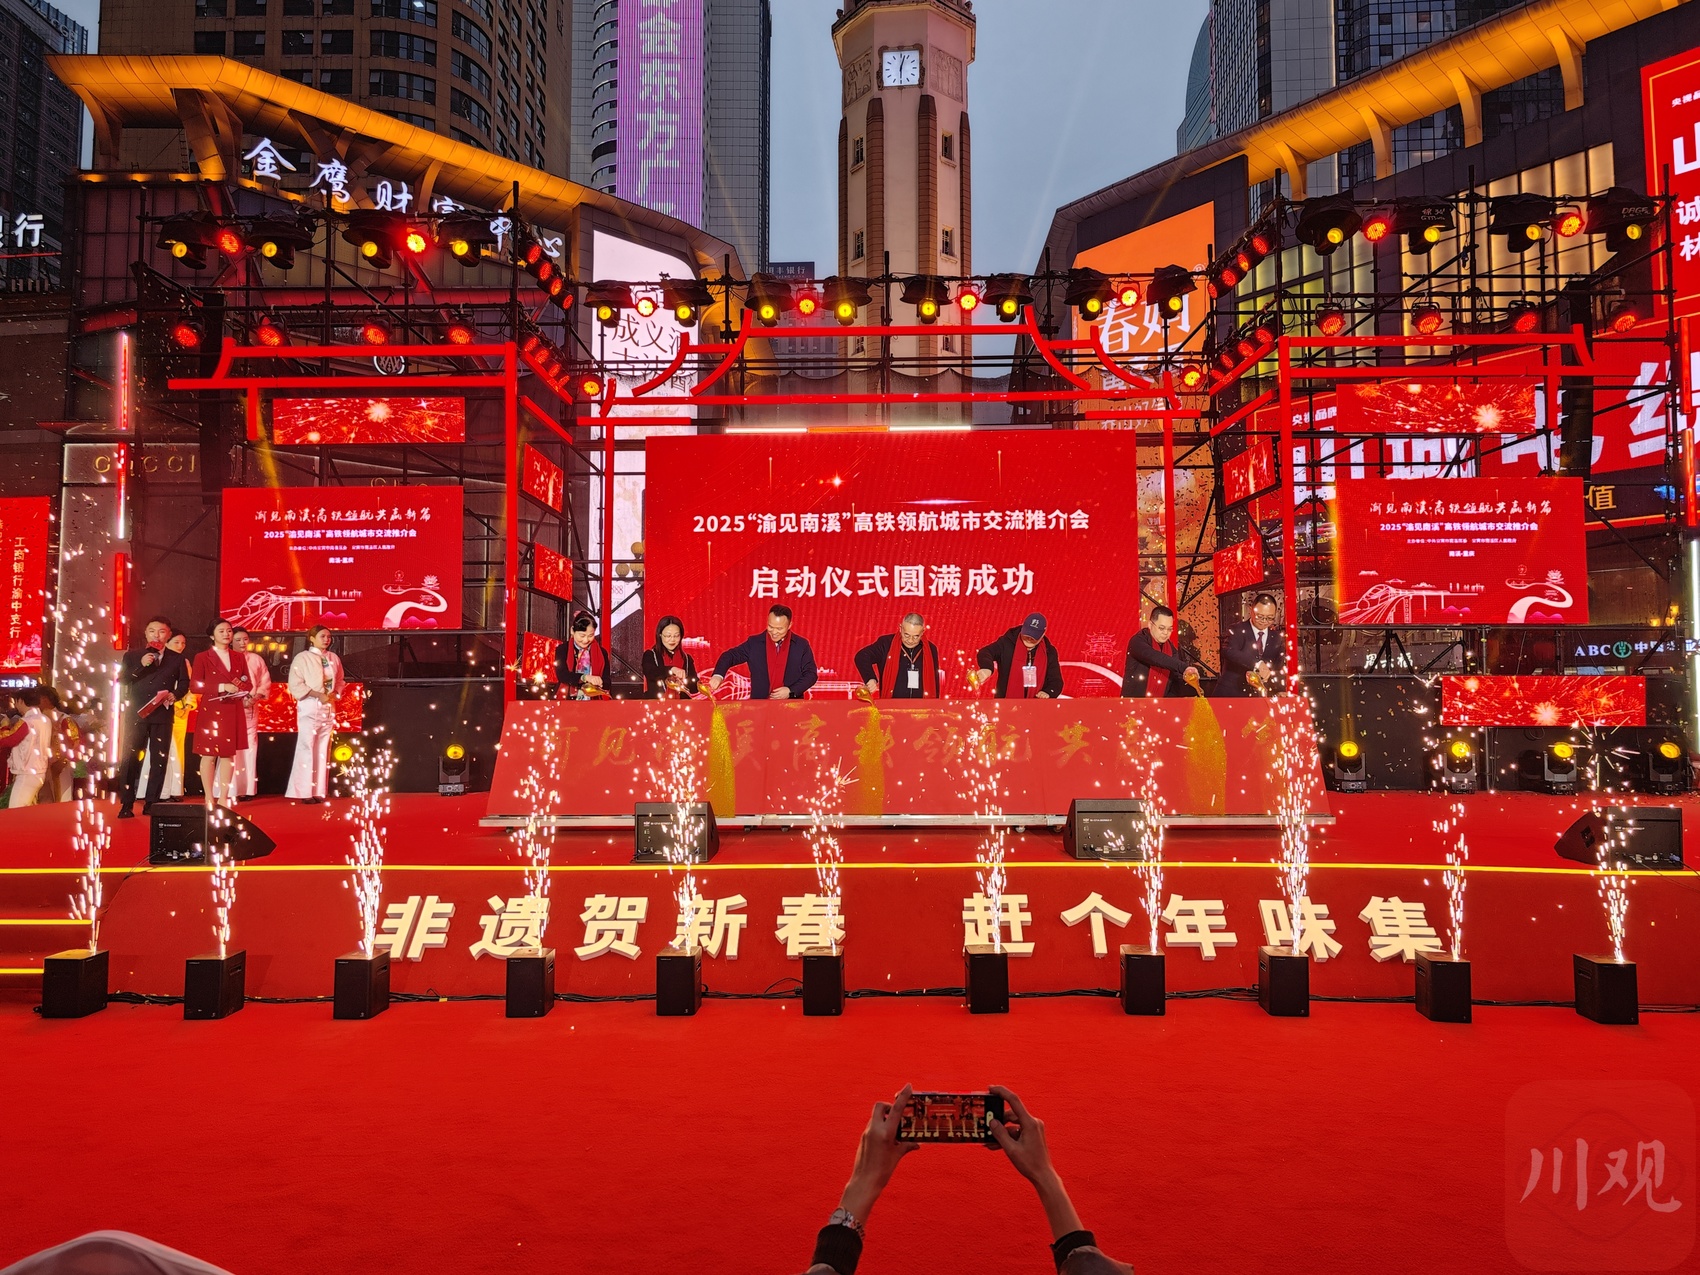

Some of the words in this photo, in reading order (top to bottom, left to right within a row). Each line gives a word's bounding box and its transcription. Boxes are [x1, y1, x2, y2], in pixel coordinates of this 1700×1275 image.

[635, 0, 682, 219] 会东方广
[9, 536, 26, 639] 工商银行渝中支行
[748, 563, 1035, 599] 启动仪式圆满成功
[1574, 644, 1611, 657] ABC
[374, 893, 846, 962] 非遗贺新春
[961, 891, 1447, 963] 赶个年味集
